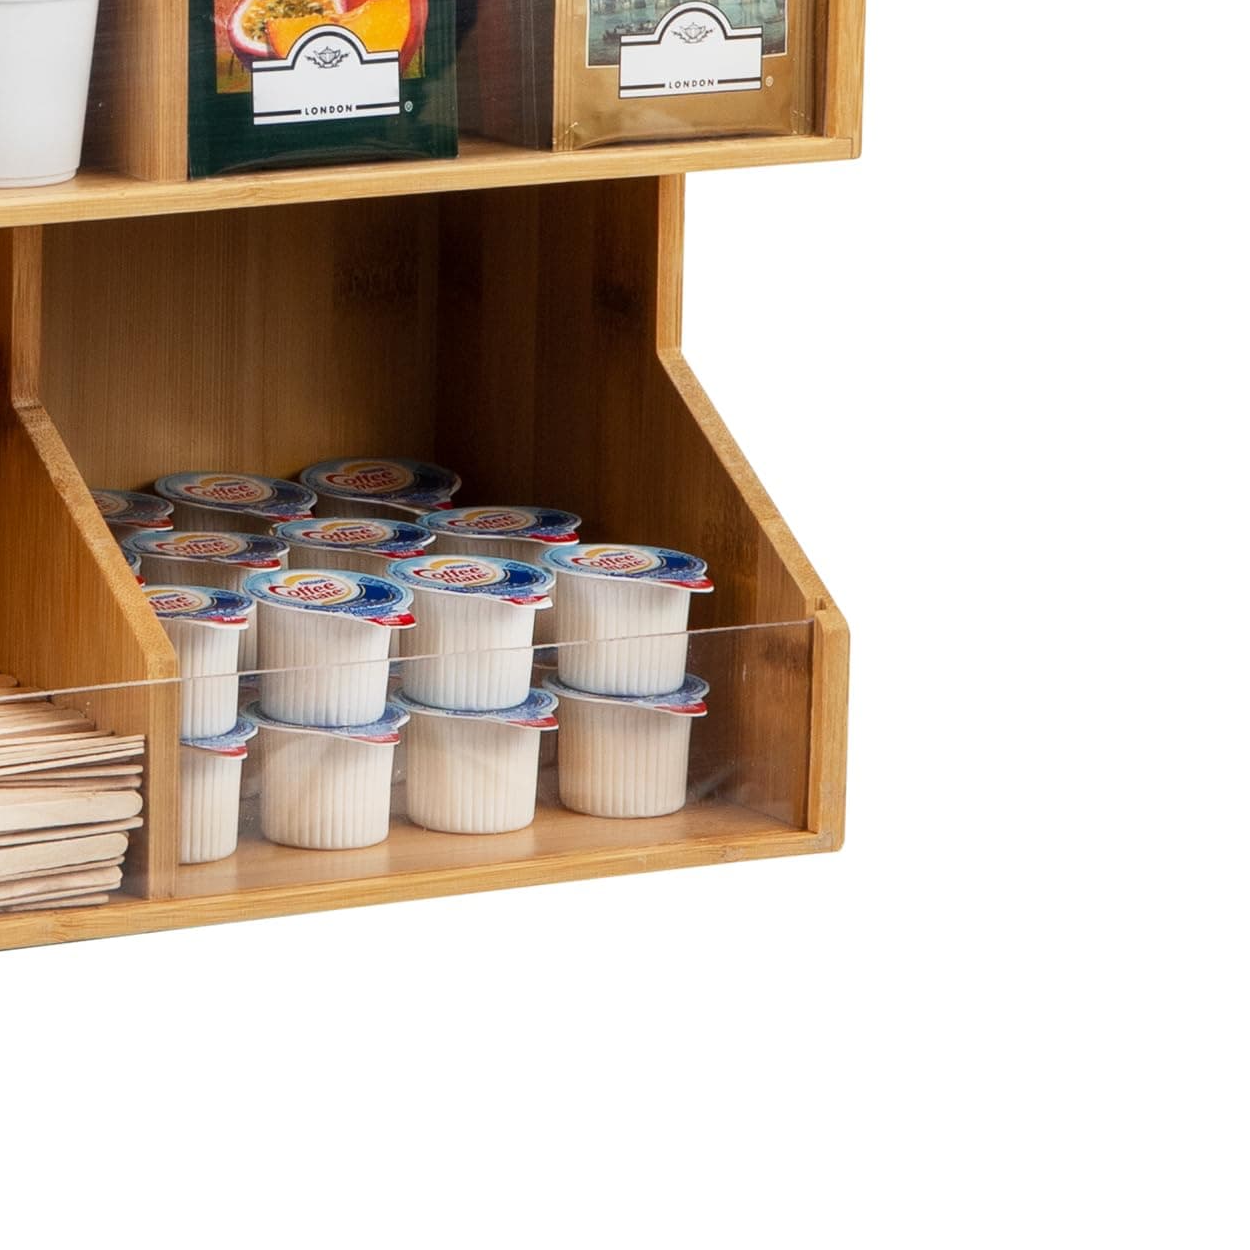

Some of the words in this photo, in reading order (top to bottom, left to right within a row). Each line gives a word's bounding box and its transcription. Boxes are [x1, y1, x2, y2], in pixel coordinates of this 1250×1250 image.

[668, 78, 715, 89] LONDON
[304, 104, 353, 116] LONDON
[183, 484, 250, 498] Coffee
[301, 528, 373, 541] Coffee
[571, 553, 636, 568] Coffee
[412, 567, 482, 580] Coffee
[268, 581, 335, 598] Coffee
[299, 588, 342, 602] mate
